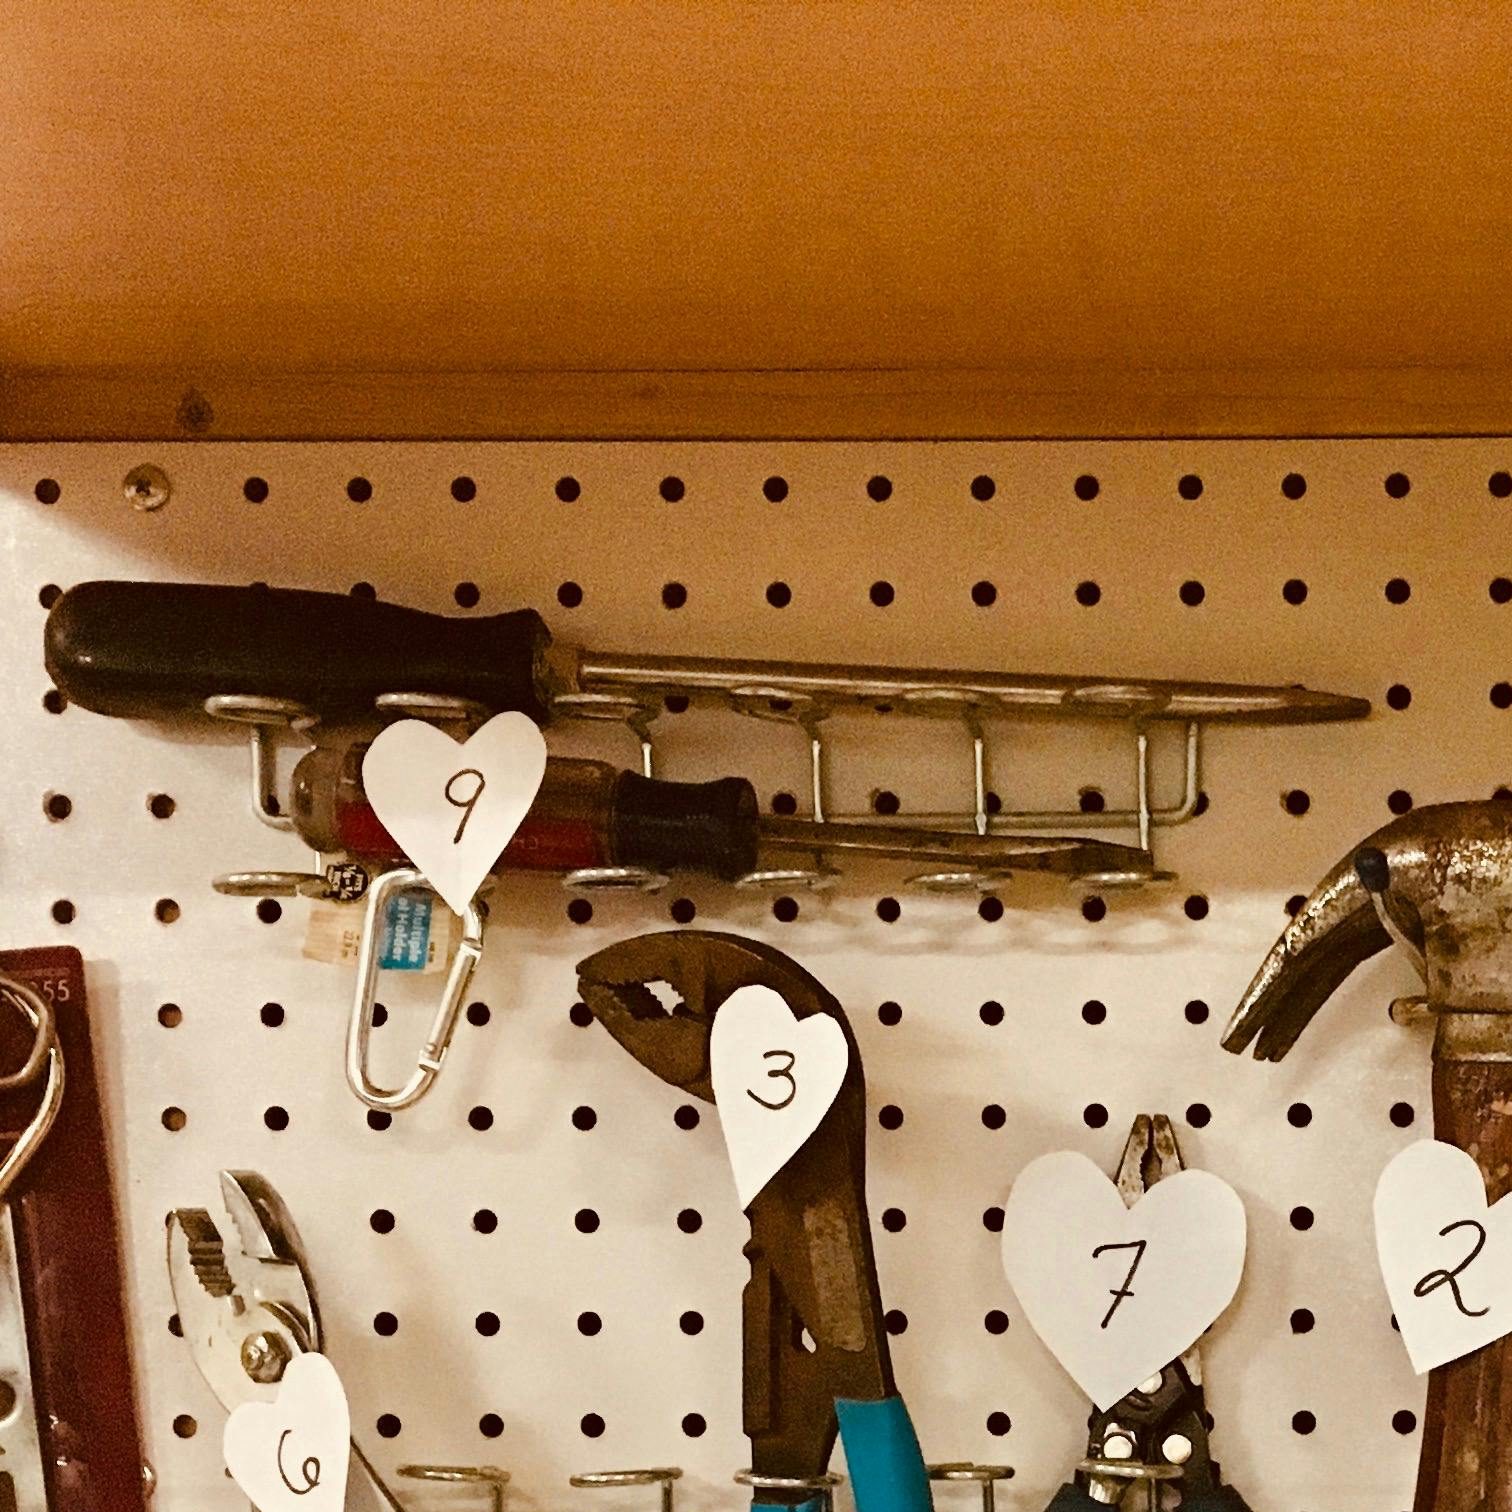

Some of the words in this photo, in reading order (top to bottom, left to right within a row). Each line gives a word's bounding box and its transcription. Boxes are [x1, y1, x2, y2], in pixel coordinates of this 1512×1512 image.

[444, 768, 486, 845] 9
[392, 912, 409, 962] Holder
[746, 1049, 797, 1110] 3
[1092, 1239, 1147, 1330] 7
[1413, 1219, 1489, 1317] 2
[278, 1429, 321, 1495] 6
